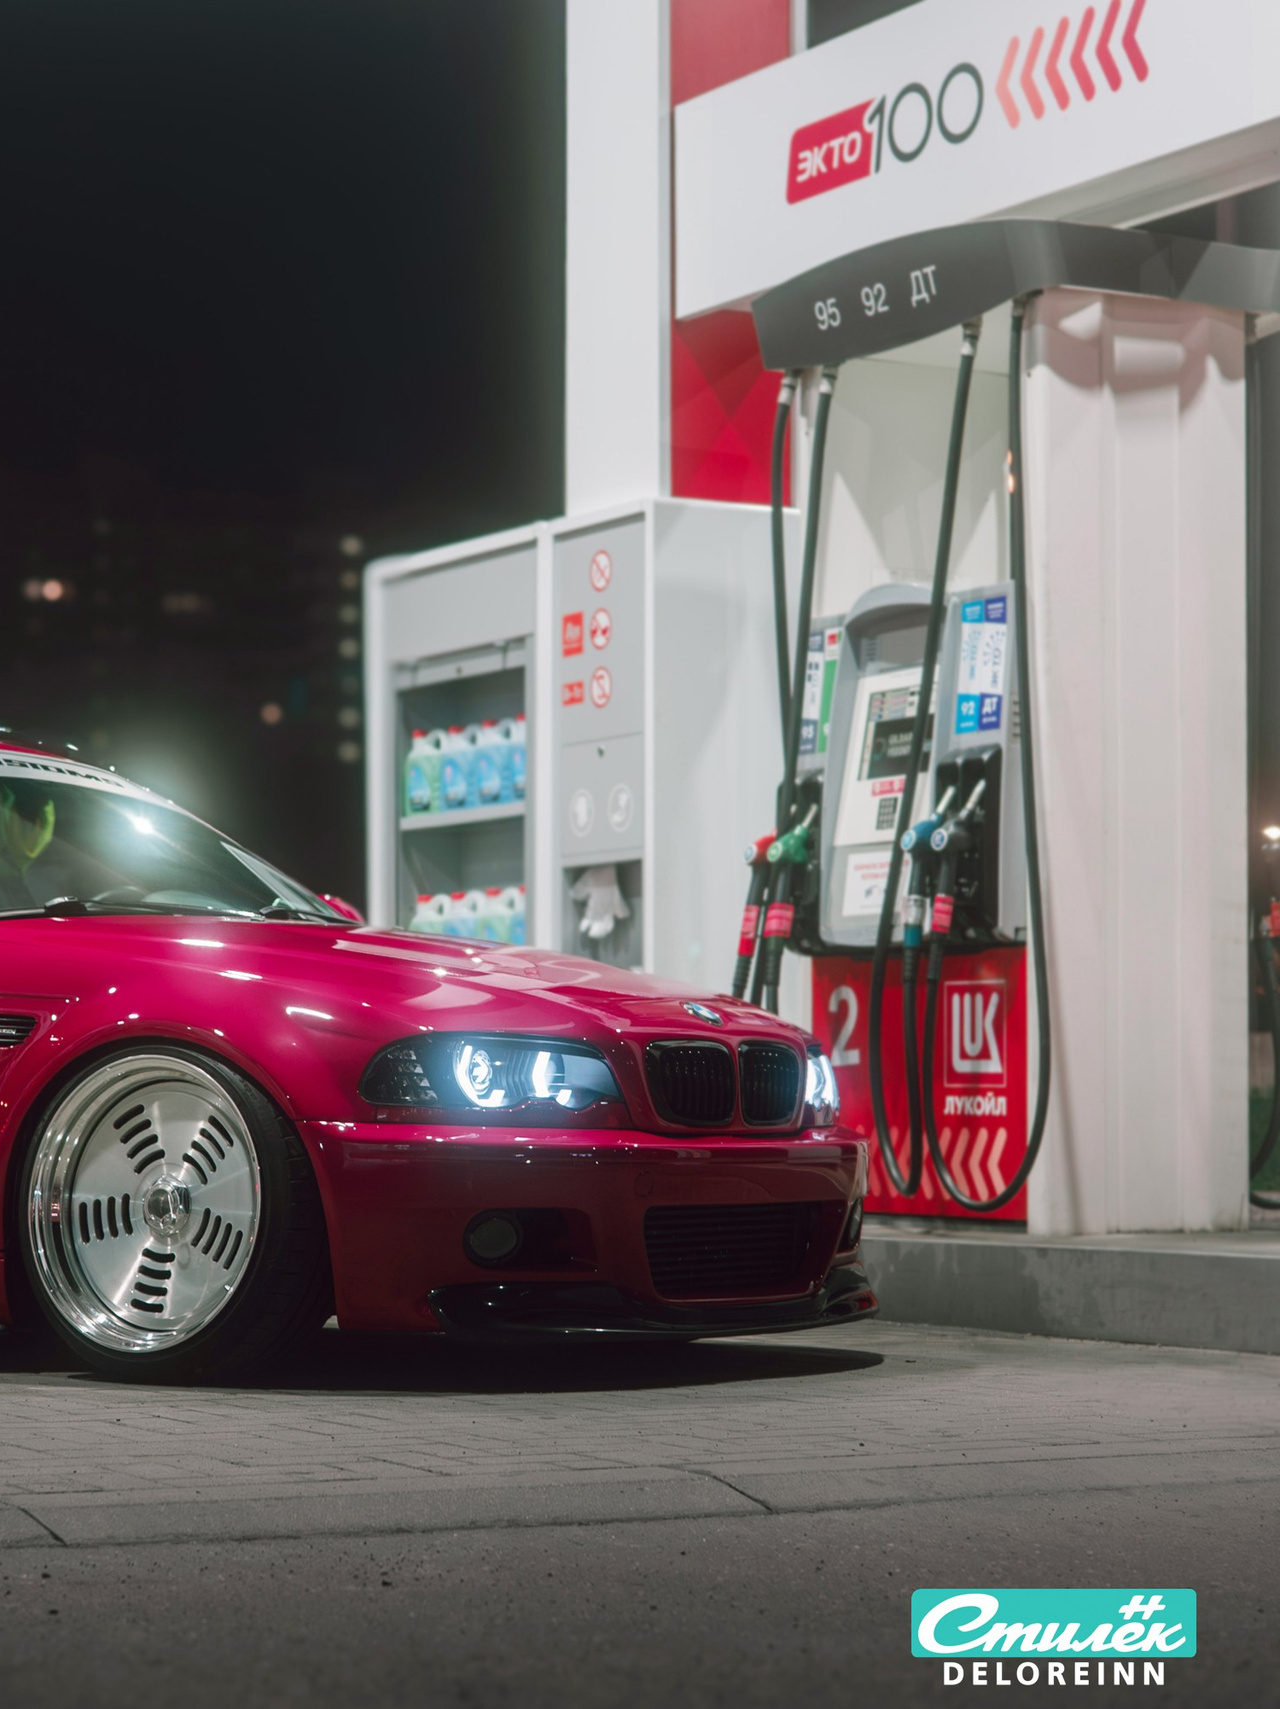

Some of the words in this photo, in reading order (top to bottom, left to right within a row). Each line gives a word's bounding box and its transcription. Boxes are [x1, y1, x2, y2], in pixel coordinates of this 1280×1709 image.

[796, 131, 862, 183] ЭКТО
[867, 62, 984, 174] 100
[814, 297, 841, 330] 95
[861, 282, 888, 317] 92
[910, 265, 939, 307] ДТ
[828, 985, 860, 1067] 2
[944, 1092, 1007, 1116] ЛУКОЙЛ
